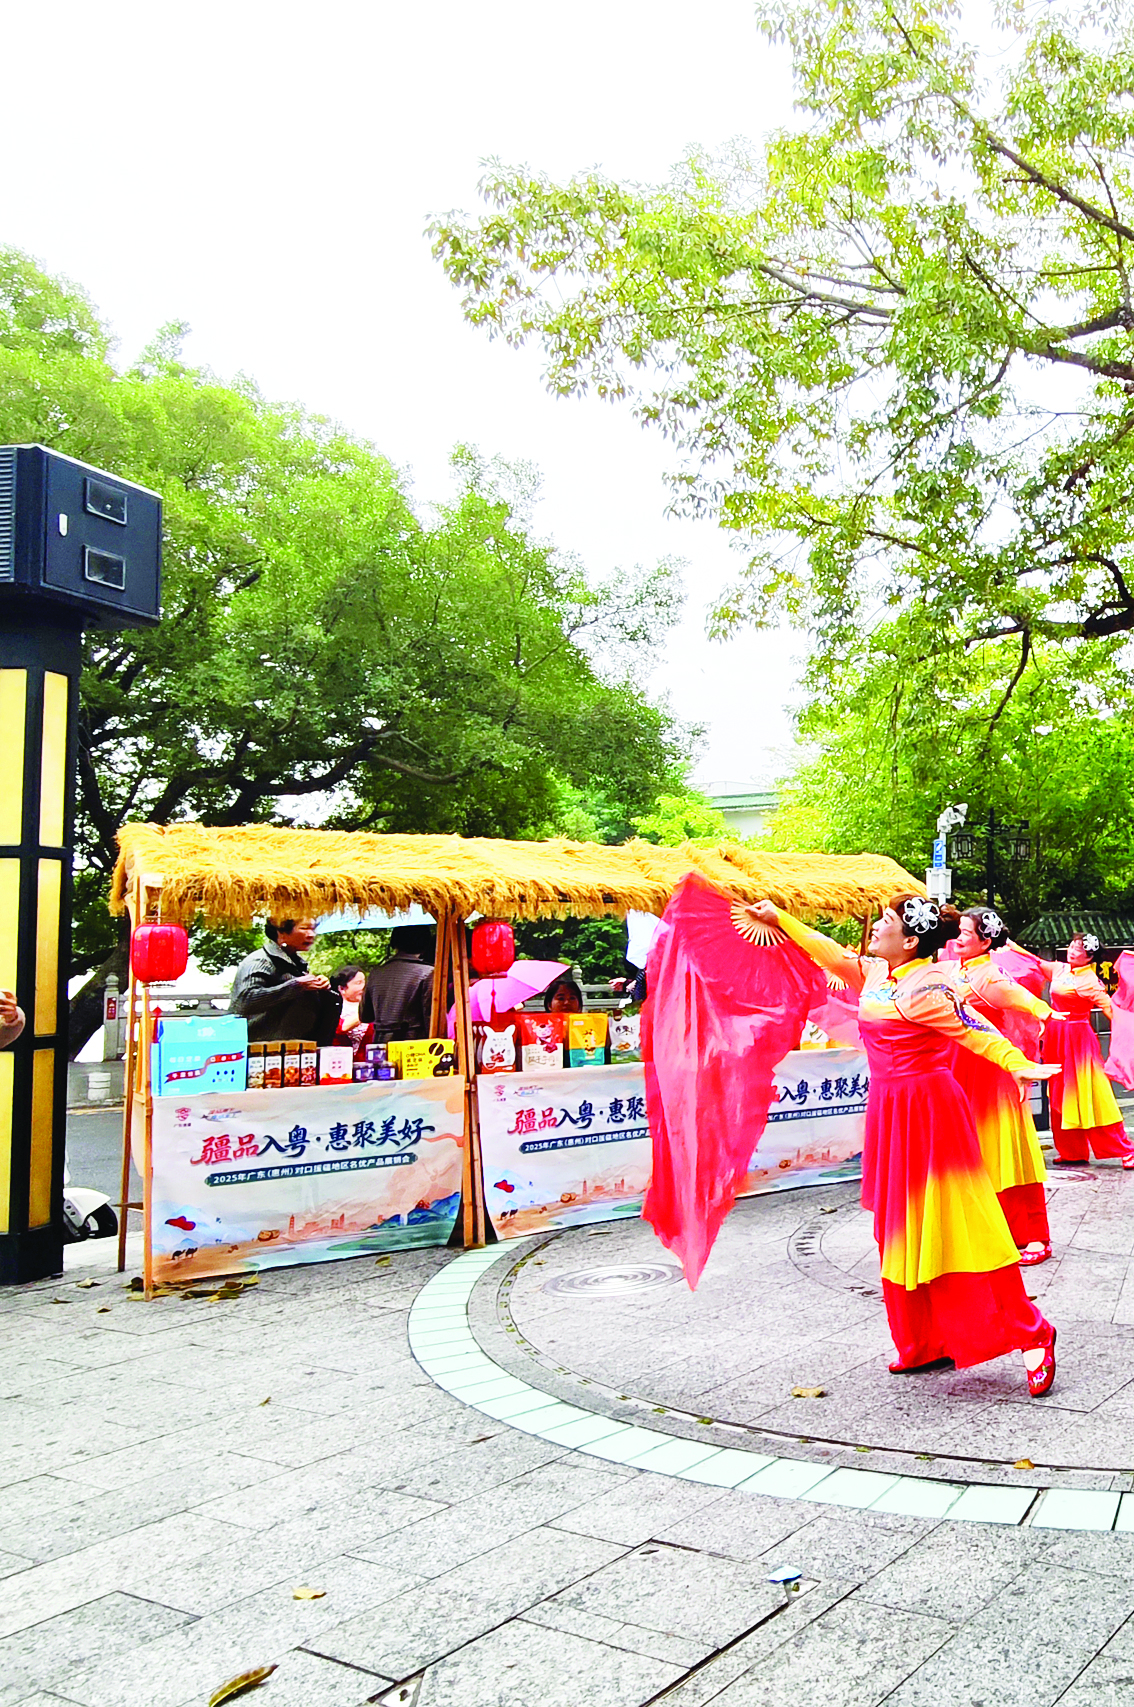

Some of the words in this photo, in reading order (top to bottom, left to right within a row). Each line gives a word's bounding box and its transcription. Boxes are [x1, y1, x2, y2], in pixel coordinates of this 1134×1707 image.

[190, 1115, 435, 1166] 疆品入粤·惠聚美好
